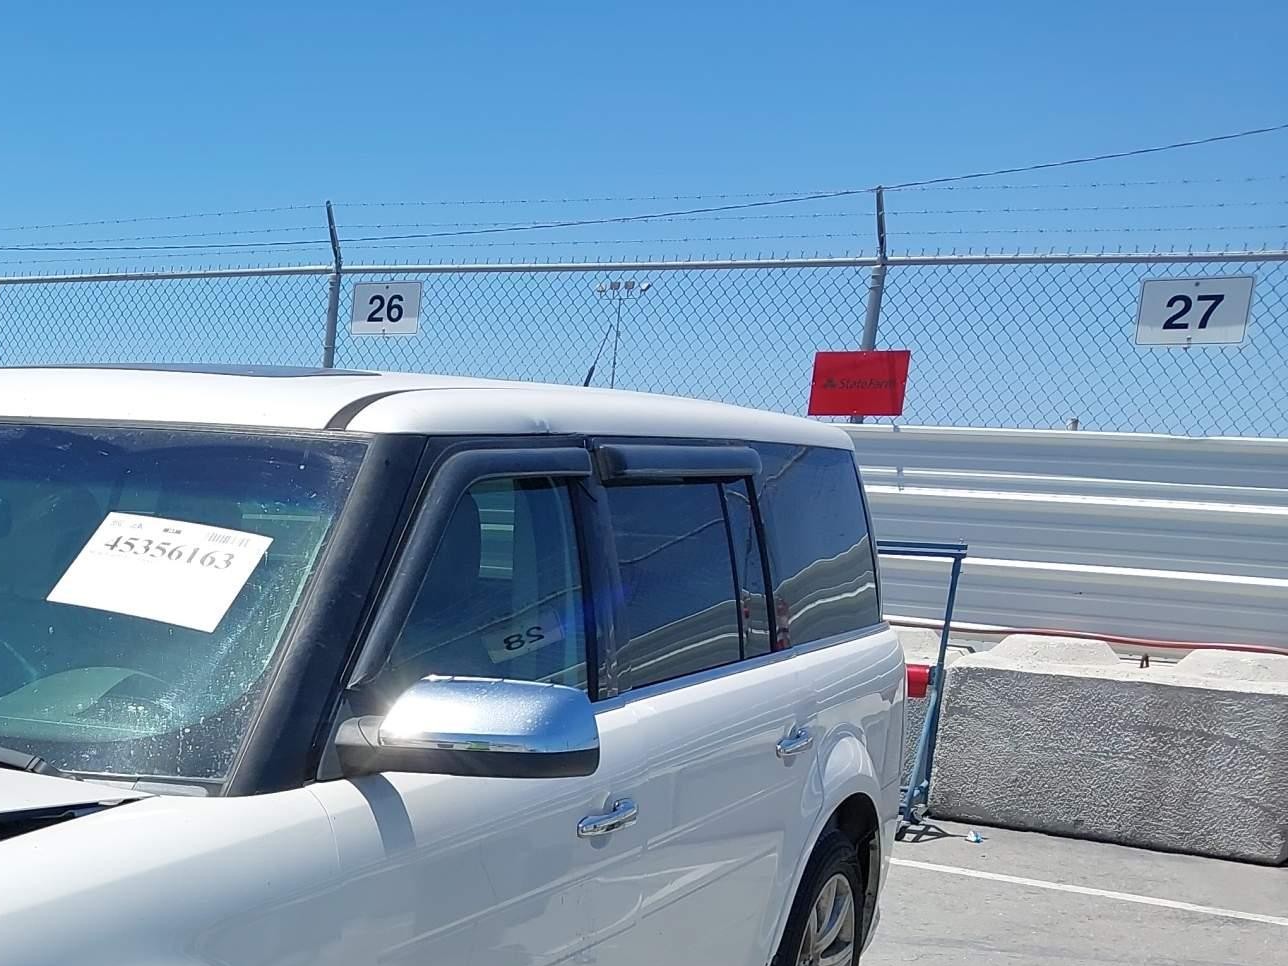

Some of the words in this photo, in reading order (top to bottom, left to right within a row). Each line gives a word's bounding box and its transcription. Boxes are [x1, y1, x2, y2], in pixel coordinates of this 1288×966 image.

[366, 294, 404, 323] 26
[1162, 294, 1225, 330] 27
[104, 535, 235, 570] 45356163
